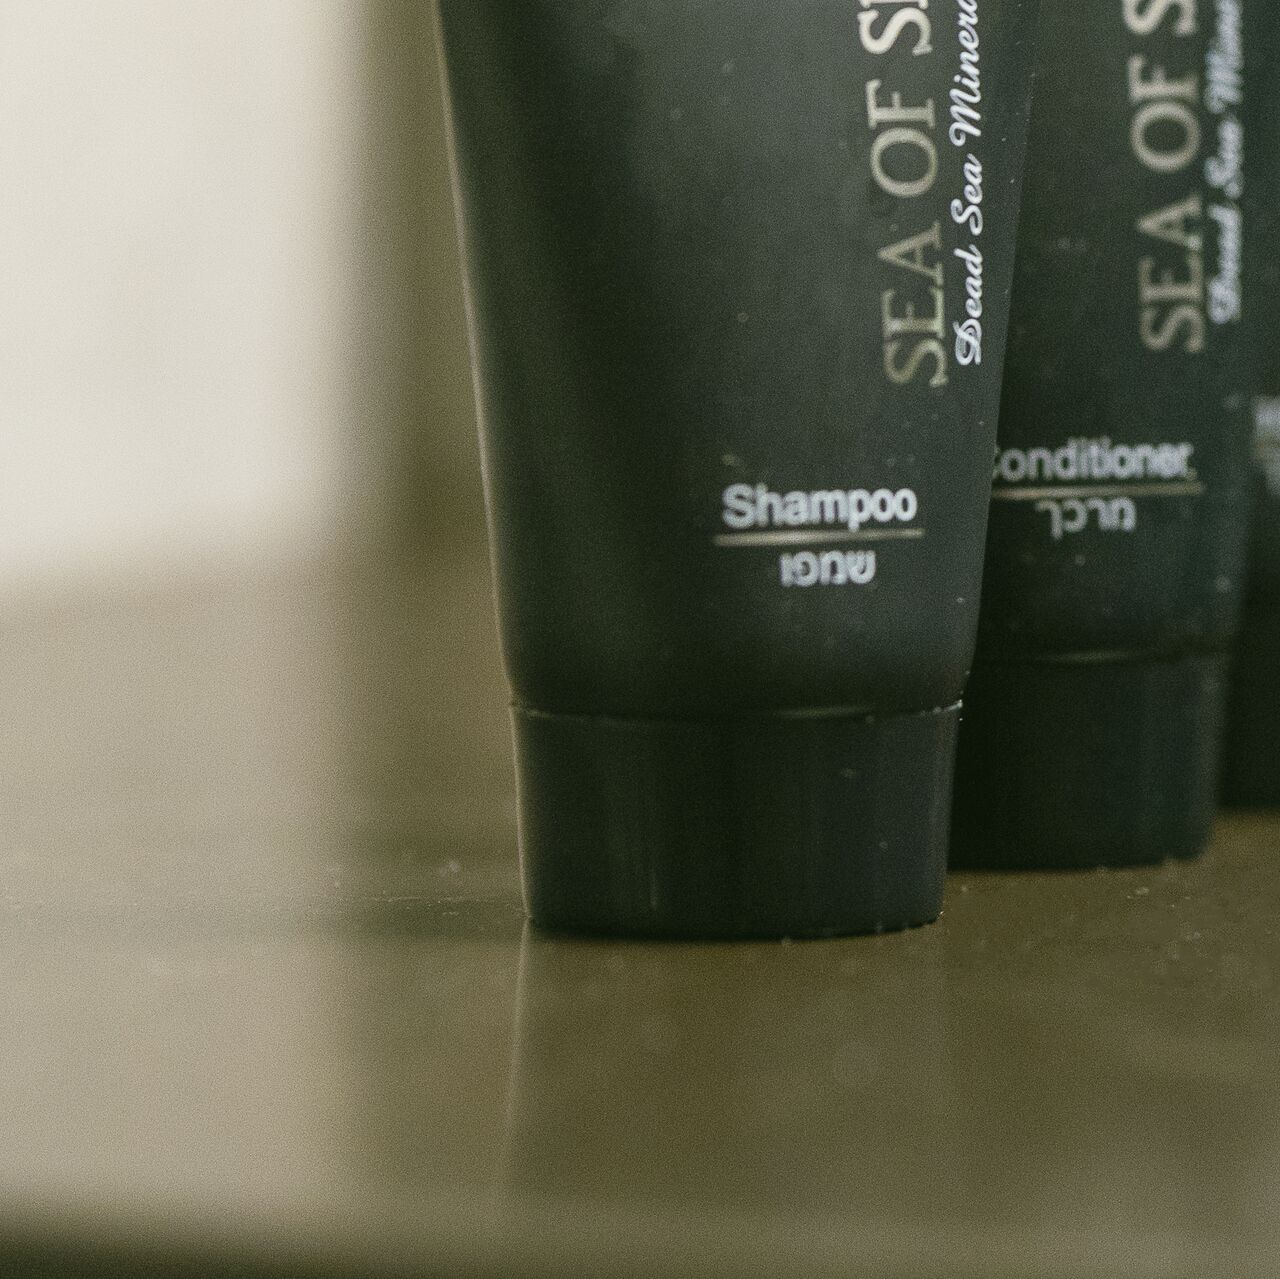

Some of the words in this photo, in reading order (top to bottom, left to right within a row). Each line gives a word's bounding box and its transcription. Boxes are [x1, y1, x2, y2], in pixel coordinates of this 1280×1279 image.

[866, 78, 939, 198] OF
[1127, 54, 1201, 173] OF
[950, 153, 985, 236] Sea
[878, 221, 949, 388] SEA
[953, 244, 984, 366] Dead
[1136, 193, 1205, 354] SEA
[721, 482, 919, 534] Shampoo
[993, 435, 1194, 481] onditioner
[779, 550, 877, 588] שמפו
